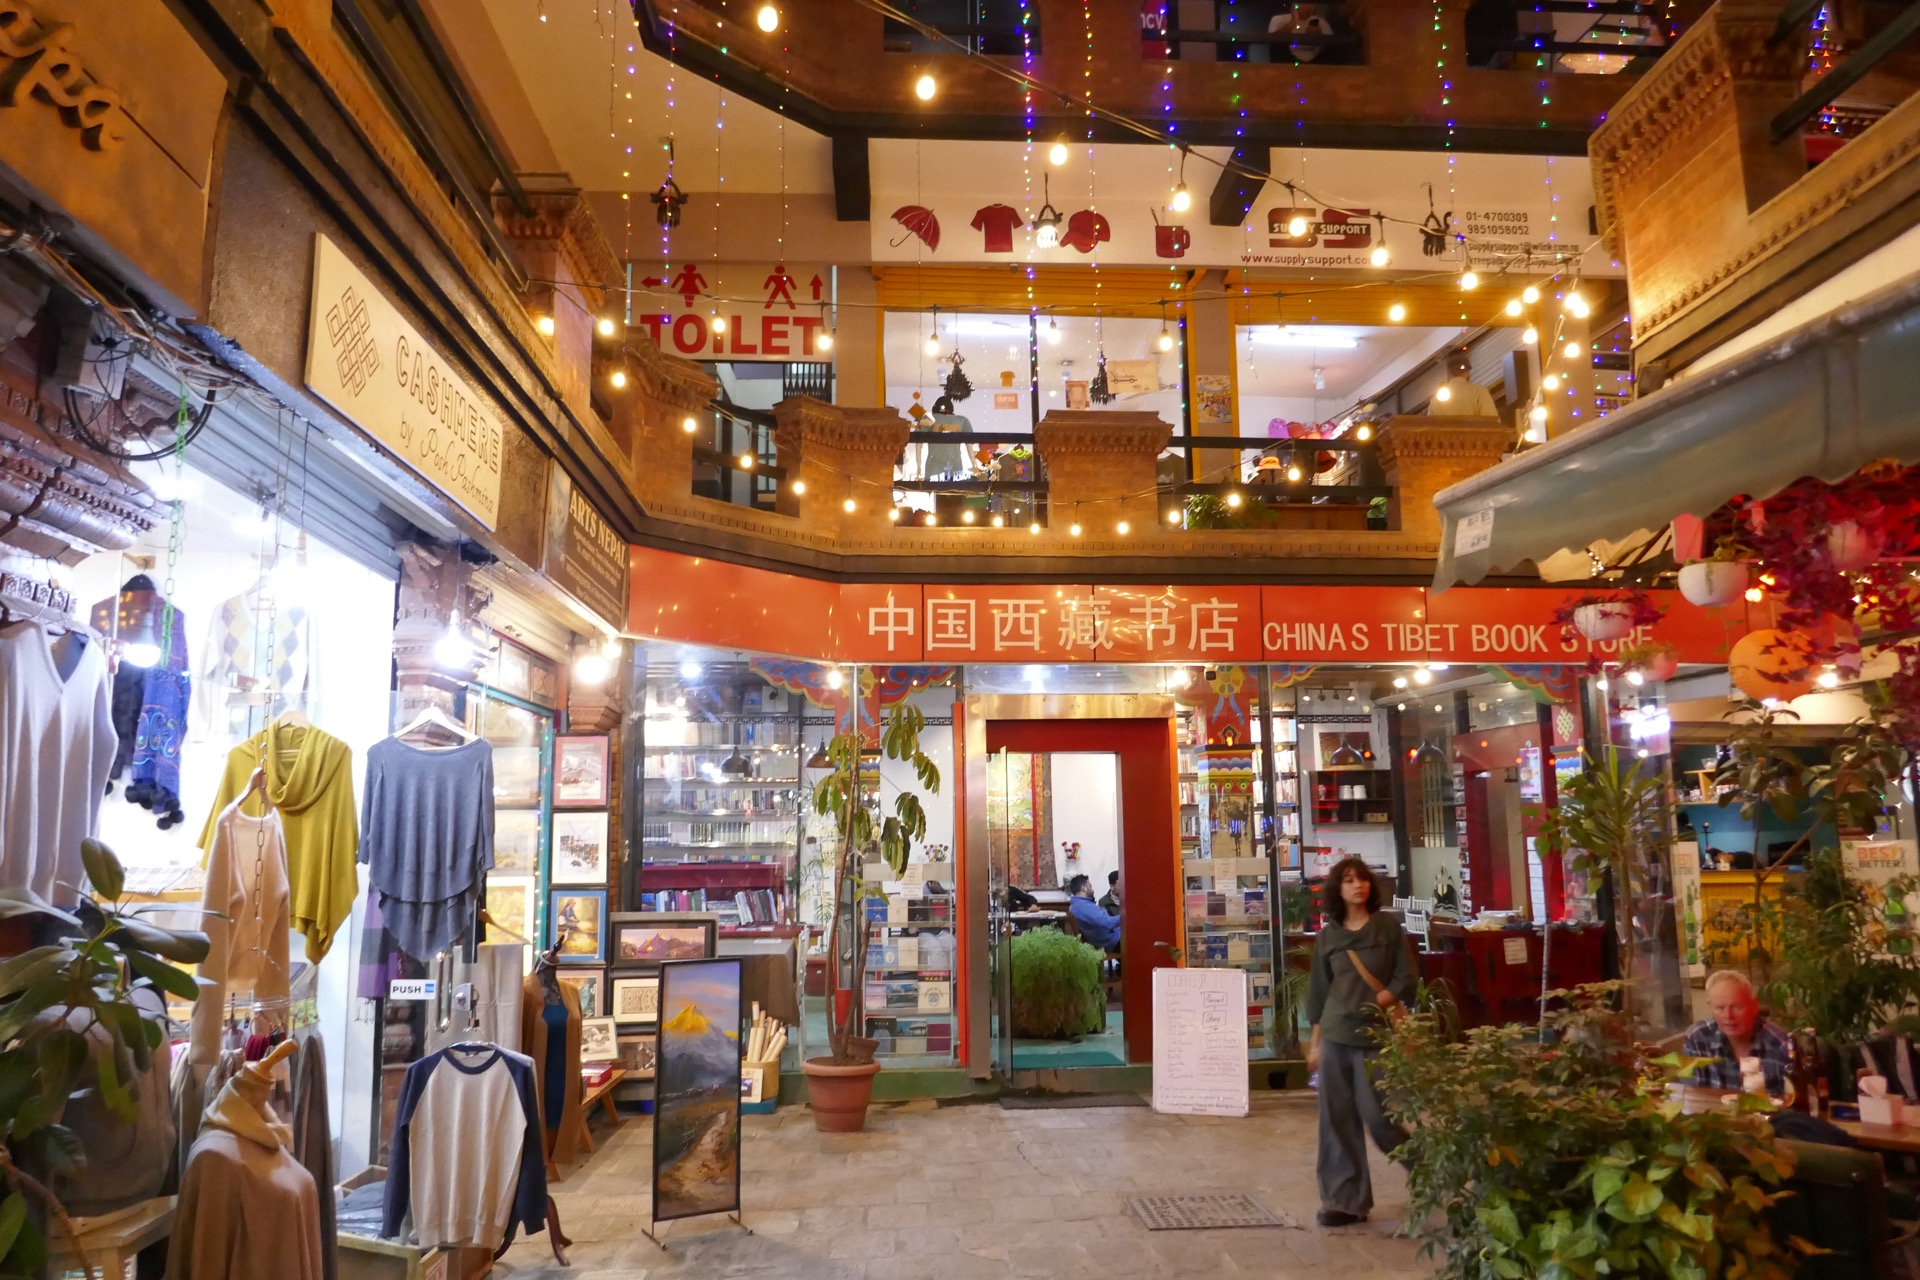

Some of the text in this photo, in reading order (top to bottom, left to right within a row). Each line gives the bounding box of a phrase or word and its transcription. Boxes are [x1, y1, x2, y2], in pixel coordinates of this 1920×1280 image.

[1273, 222, 1368, 235] SUY SUPPORT
[1466, 211, 1528, 222] 01-4700309
[1467, 224, 1530, 235] 9851058052
[1241, 253, 1393, 267] www.supplysupport.cop
[640, 314, 823, 355] TOILET
[396, 335, 500, 475] CASHMERE
[400, 412, 495, 514] by Posh Pashmina
[569, 489, 598, 538] ARTS
[598, 519, 626, 570] NEPAL
[868, 595, 1239, 652] 中国西藏书店
[1381, 623, 1459, 652] TIBET
[1472, 624, 1549, 653] BOOK
[392, 985, 422, 994] PUSH
